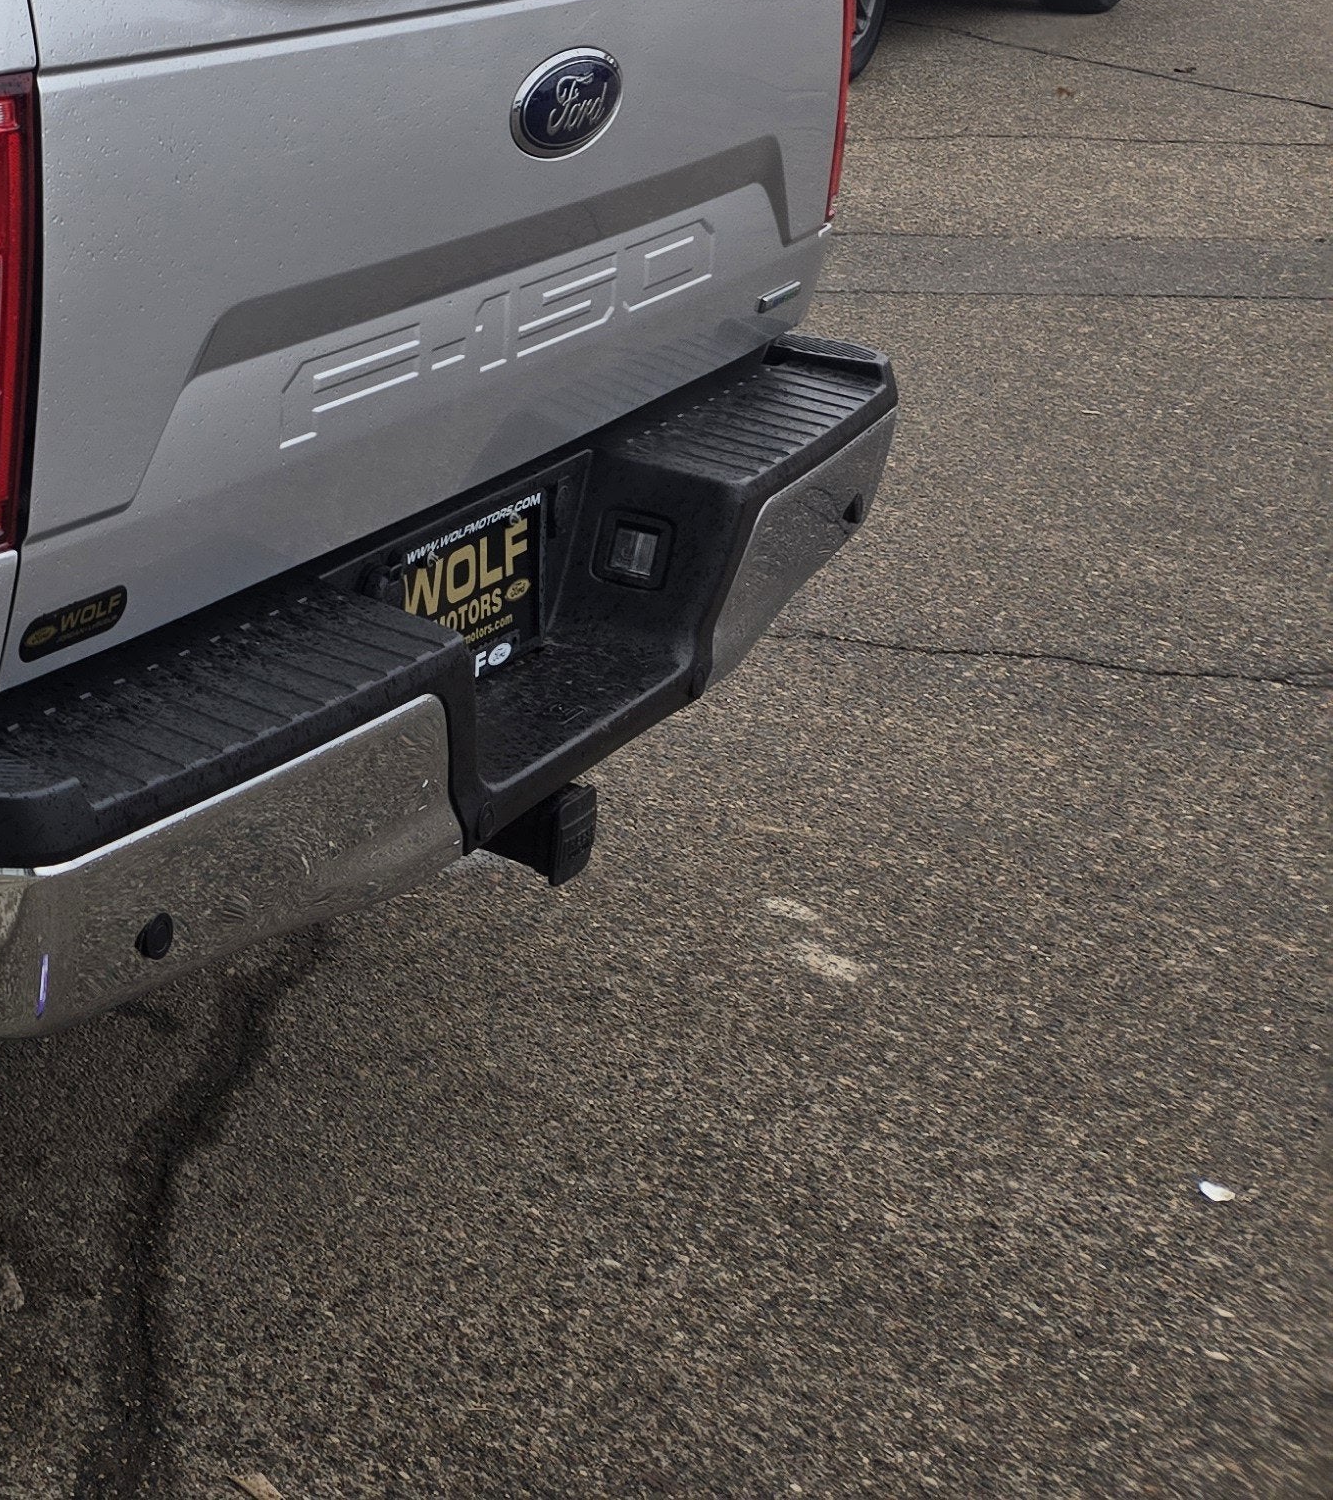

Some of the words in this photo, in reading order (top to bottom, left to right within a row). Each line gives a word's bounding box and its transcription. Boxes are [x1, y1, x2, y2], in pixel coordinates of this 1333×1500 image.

[546, 71, 608, 136] Ford
[279, 217, 716, 449] F-150
[406, 492, 541, 565] WWW.WOLFMOTORS.COM
[404, 517, 528, 616] WOLF
[60, 593, 122, 632] WOLF
